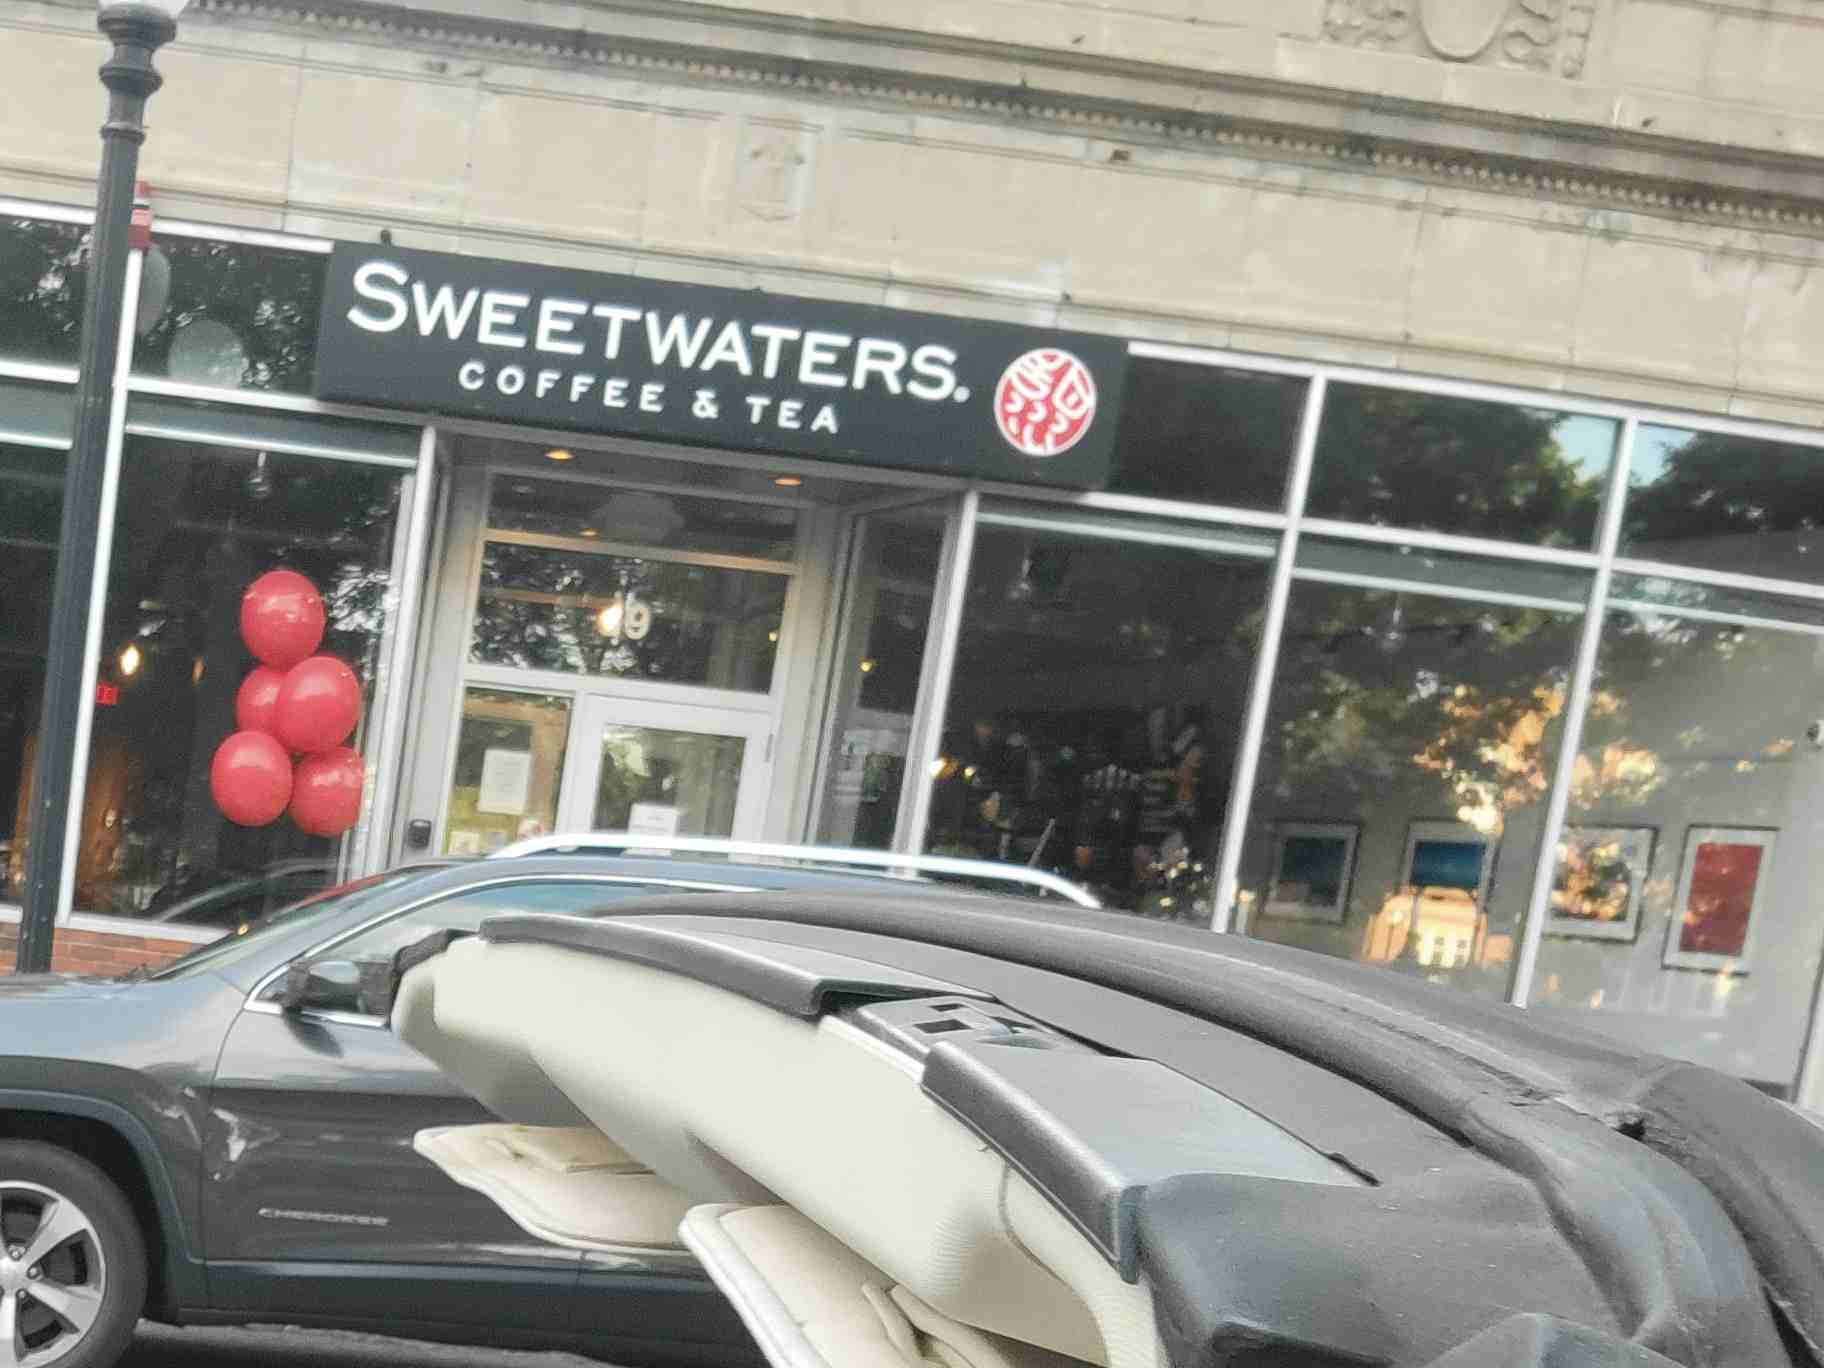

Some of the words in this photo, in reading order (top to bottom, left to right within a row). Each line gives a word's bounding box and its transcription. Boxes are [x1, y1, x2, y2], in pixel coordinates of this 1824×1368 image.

[459, 362, 665, 413] COFFEE
[693, 390, 720, 420] &
[746, 396, 838, 435] TEA
